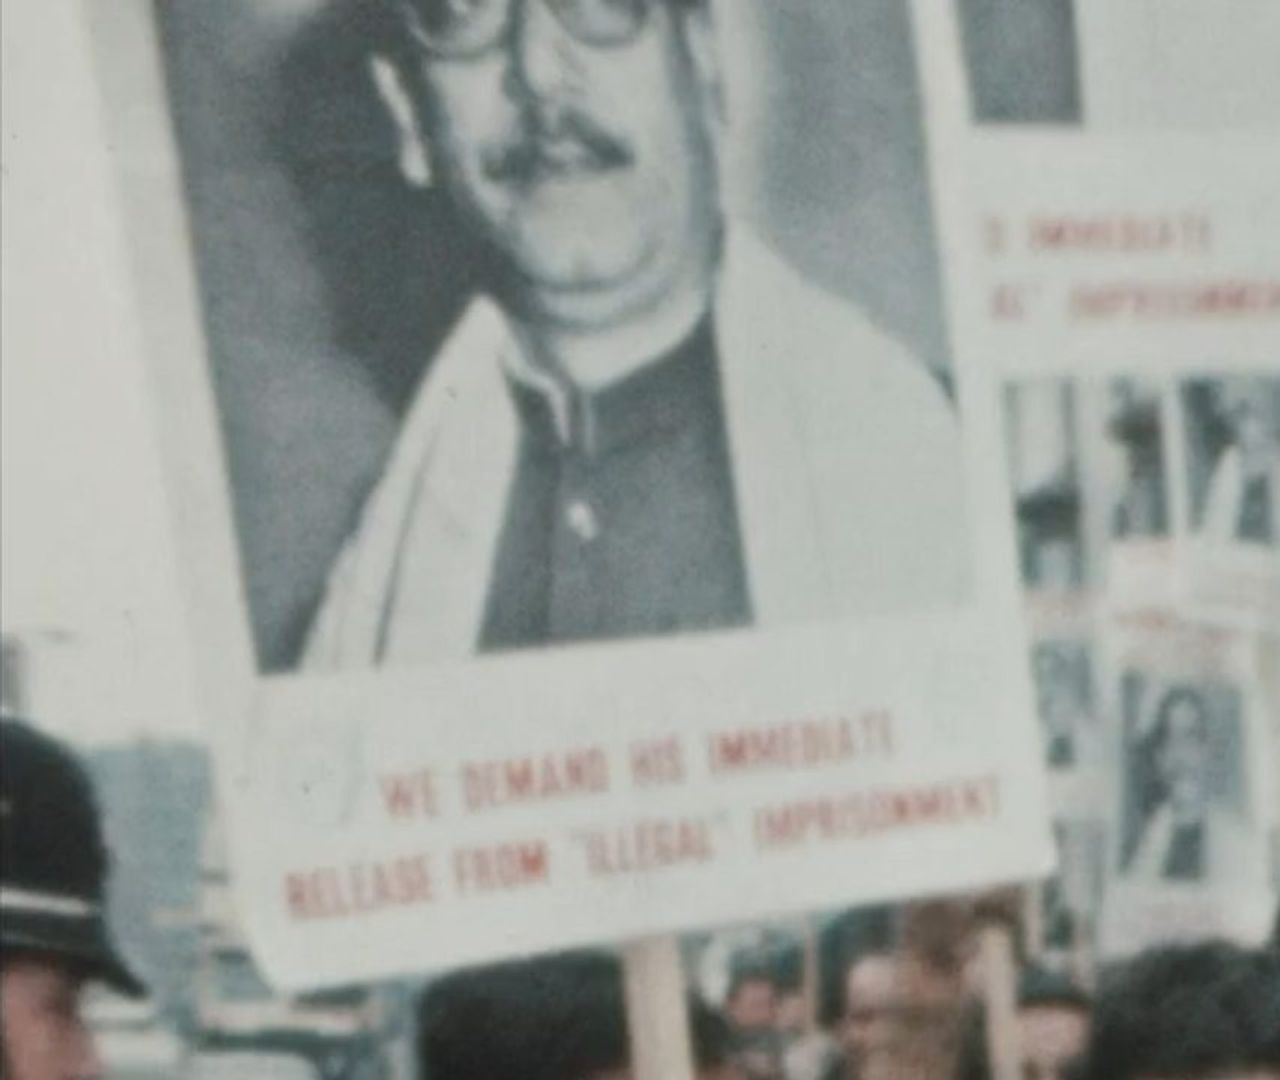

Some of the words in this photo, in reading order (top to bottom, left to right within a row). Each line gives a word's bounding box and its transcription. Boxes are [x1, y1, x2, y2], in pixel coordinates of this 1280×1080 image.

[377, 763, 440, 819] WE
[460, 744, 609, 808] DEMAND
[628, 731, 686, 783] HIS
[708, 709, 896, 776] IMMEDIATE
[283, 852, 432, 920] RELEASE
[453, 838, 550, 894] FROM
[571, 811, 727, 878] "ILLEGAL"
[752, 772, 1003, 853] IMPRISONMENT
